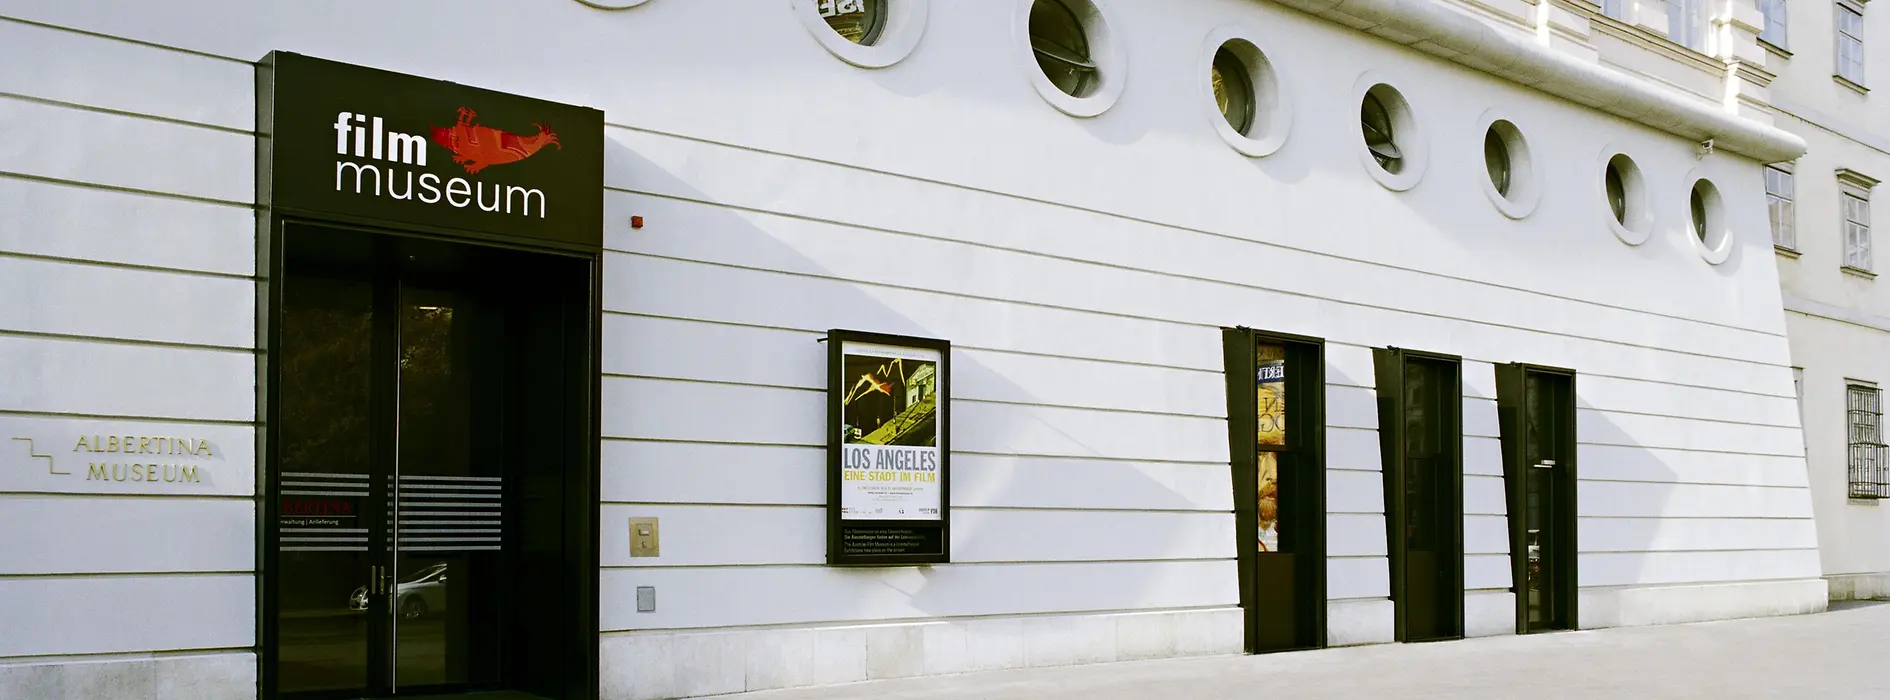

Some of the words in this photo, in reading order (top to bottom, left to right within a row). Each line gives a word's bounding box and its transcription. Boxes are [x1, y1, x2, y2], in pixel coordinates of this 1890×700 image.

[334, 111, 427, 166] film
[336, 160, 546, 219] museum
[73, 434, 213, 456] ALBERTINA
[844, 447, 871, 469] LOS
[876, 449, 936, 471] ANGELES
[86, 462, 201, 483] MUSEUM
[844, 470, 866, 481] EINE
[869, 471, 897, 481] STADT
[900, 471, 911, 482] IM
[914, 472, 936, 482] FILM
